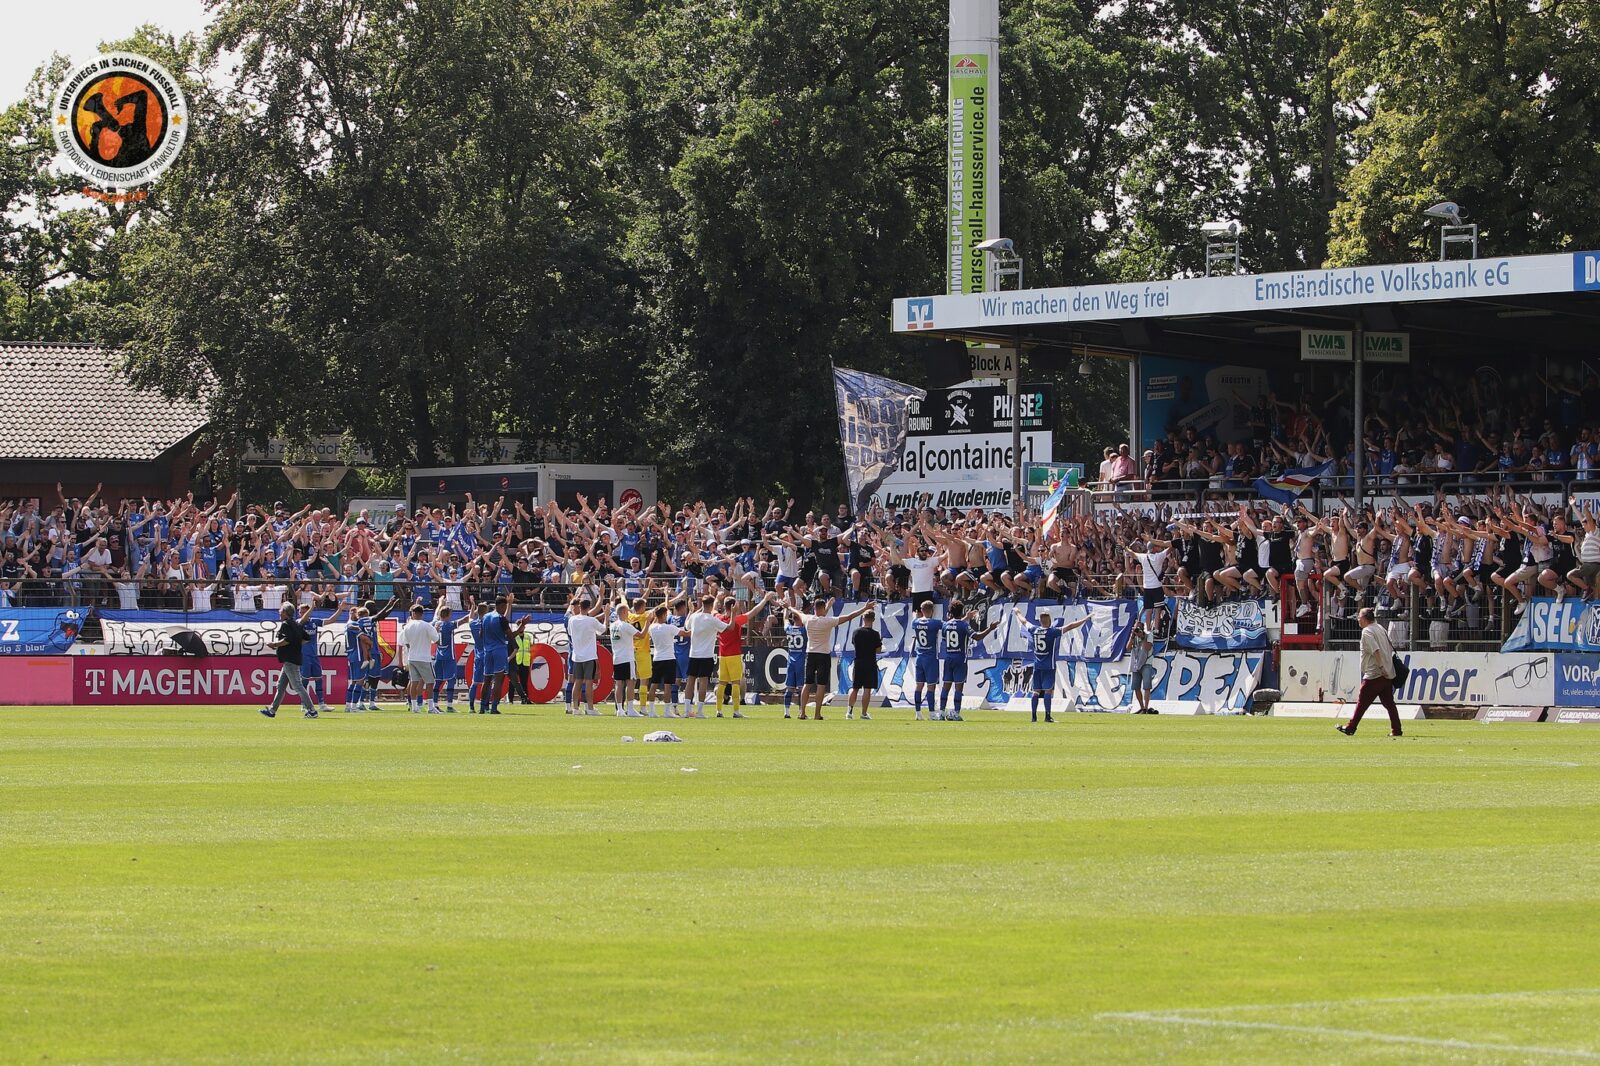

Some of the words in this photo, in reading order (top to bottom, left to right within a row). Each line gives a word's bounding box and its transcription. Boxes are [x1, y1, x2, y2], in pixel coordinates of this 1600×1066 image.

[951, 98, 964, 293] IMMELPILZBESEITIGUNG
[1255, 270, 1375, 301] Emsländische
[1381, 262, 1478, 293] Volksbank
[1484, 261, 1510, 287] eG
[982, 296, 1008, 317] Wir
[1012, 293, 1068, 316] machen
[1072, 291, 1100, 312] den
[1104, 289, 1139, 315] Weg
[1143, 286, 1170, 308] frei
[1308, 334, 1334, 349] LVM
[970, 355, 1001, 371] Block
[1004, 355, 1012, 371] A
[908, 417, 932, 431] RBUNG!
[937, 488, 1012, 507] Akademie
[787, 635, 803, 648] 20
[919, 630, 928, 647] 6
[946, 630, 959, 648] 19
[1034, 634, 1047, 652] 15
[112, 669, 246, 696] MAGENTA
